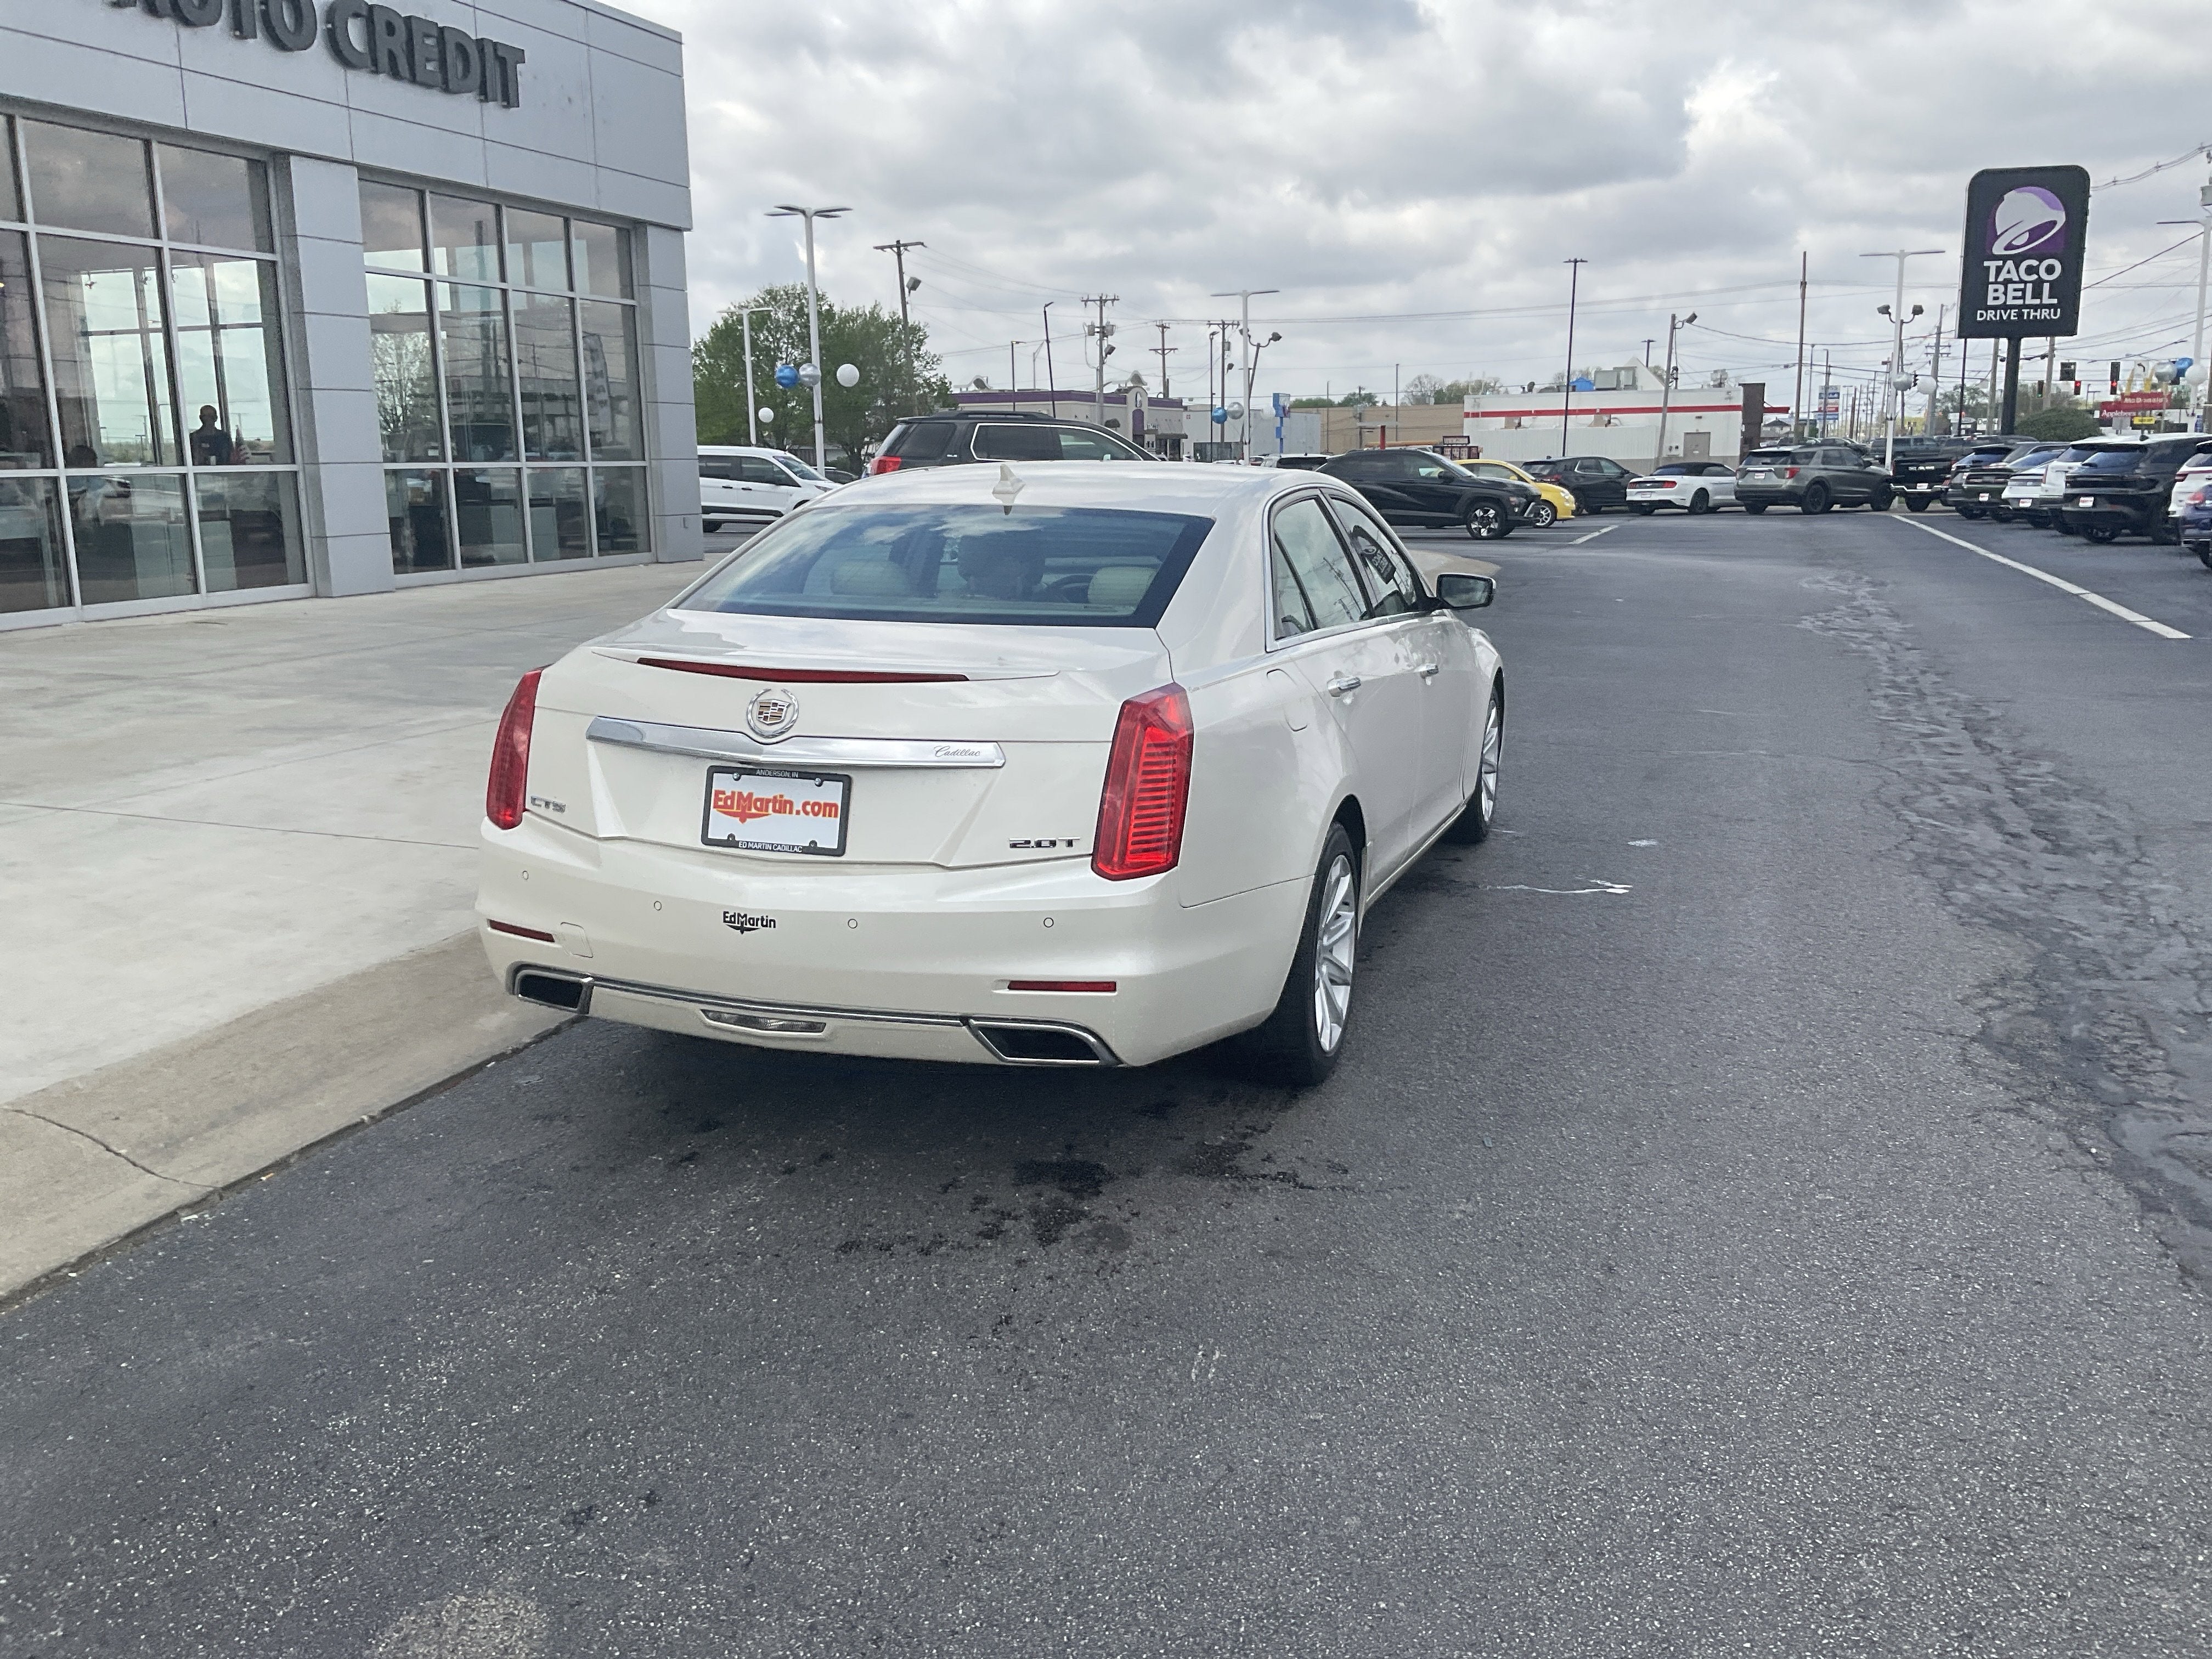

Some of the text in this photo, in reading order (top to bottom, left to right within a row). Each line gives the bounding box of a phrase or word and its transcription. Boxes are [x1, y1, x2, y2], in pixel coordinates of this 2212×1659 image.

[104, 0, 526, 108] TO CREDIT
[1983, 258, 2062, 282] TACO
[1987, 283, 2057, 306] BELL
[1976, 308, 2061, 321] DRIVE THRU
[933, 746, 980, 757] Cadillac
[531, 795, 566, 813] CTS
[748, 842, 772, 850] MARTIN
[772, 844, 803, 853] CADILLAC
